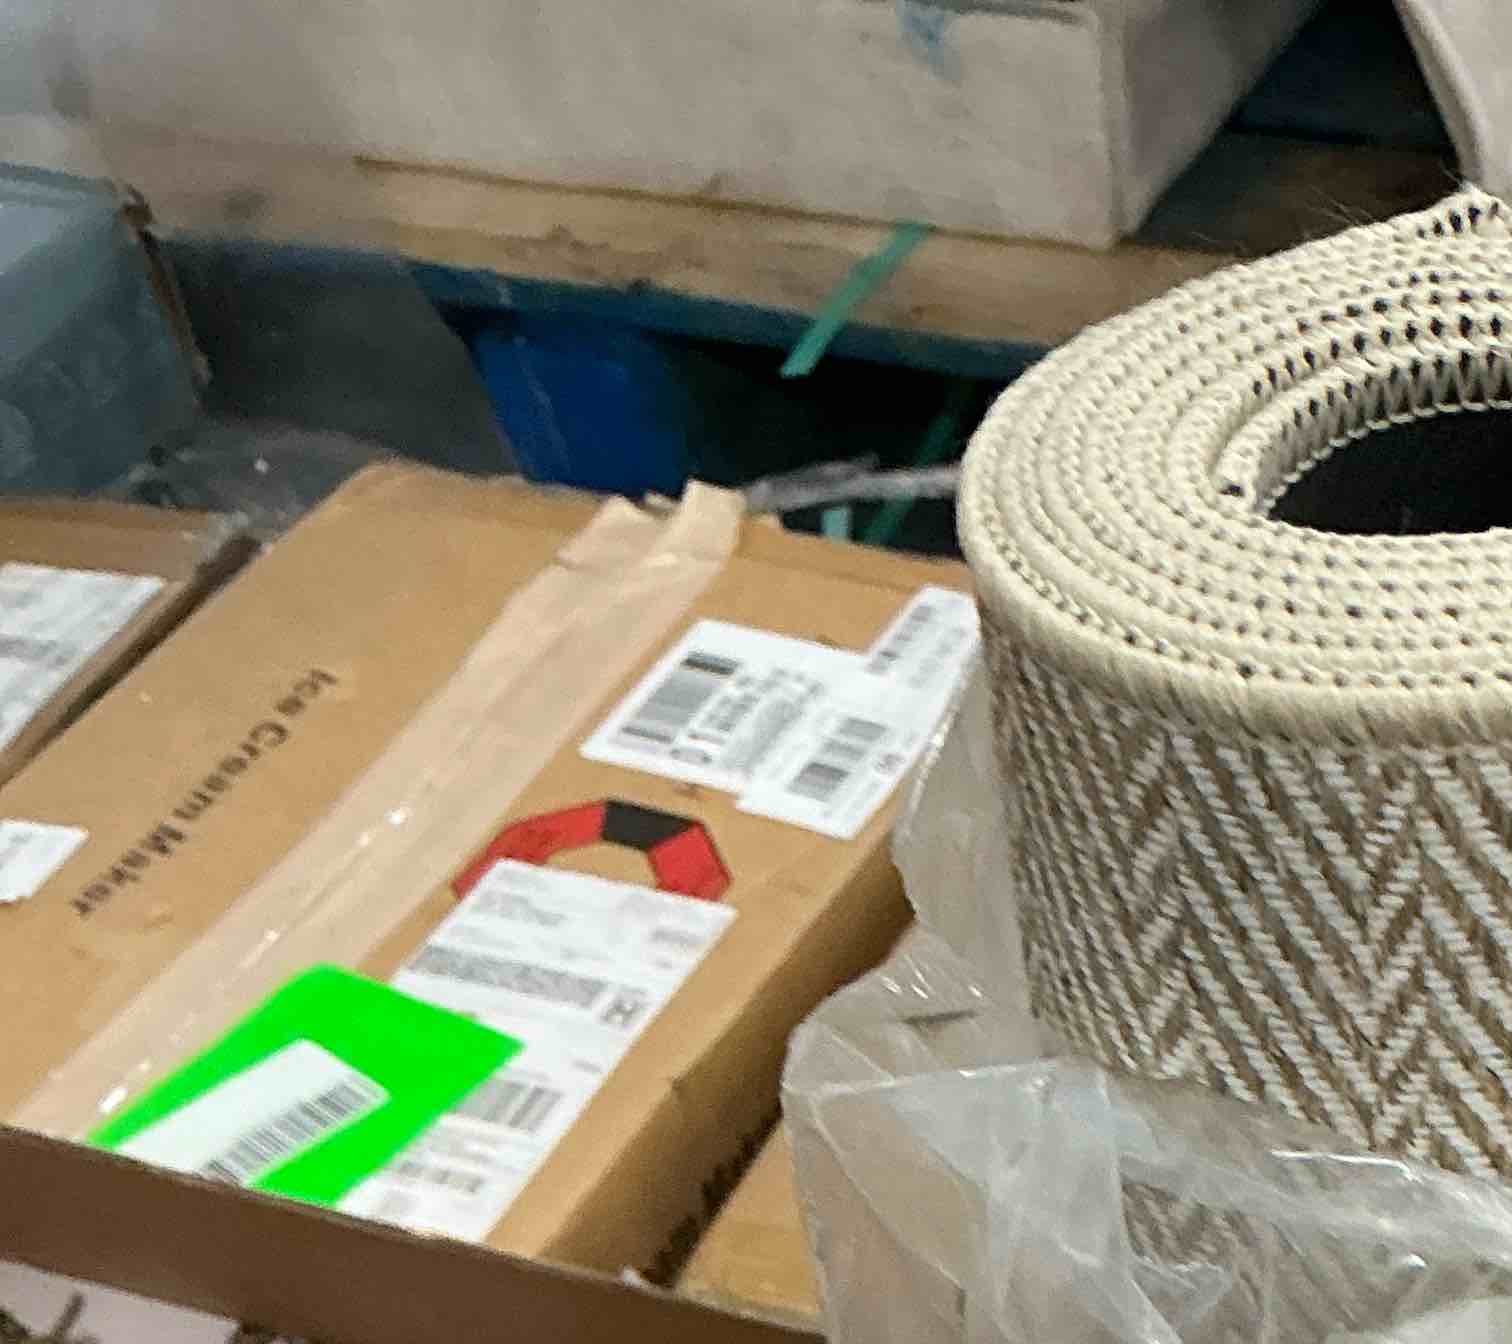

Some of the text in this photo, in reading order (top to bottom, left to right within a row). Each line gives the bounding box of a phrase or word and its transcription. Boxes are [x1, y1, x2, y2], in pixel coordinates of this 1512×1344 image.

[274, 669, 337, 717] Ice
[173, 722, 289, 821] Cream
[73, 824, 186, 916] Maker
